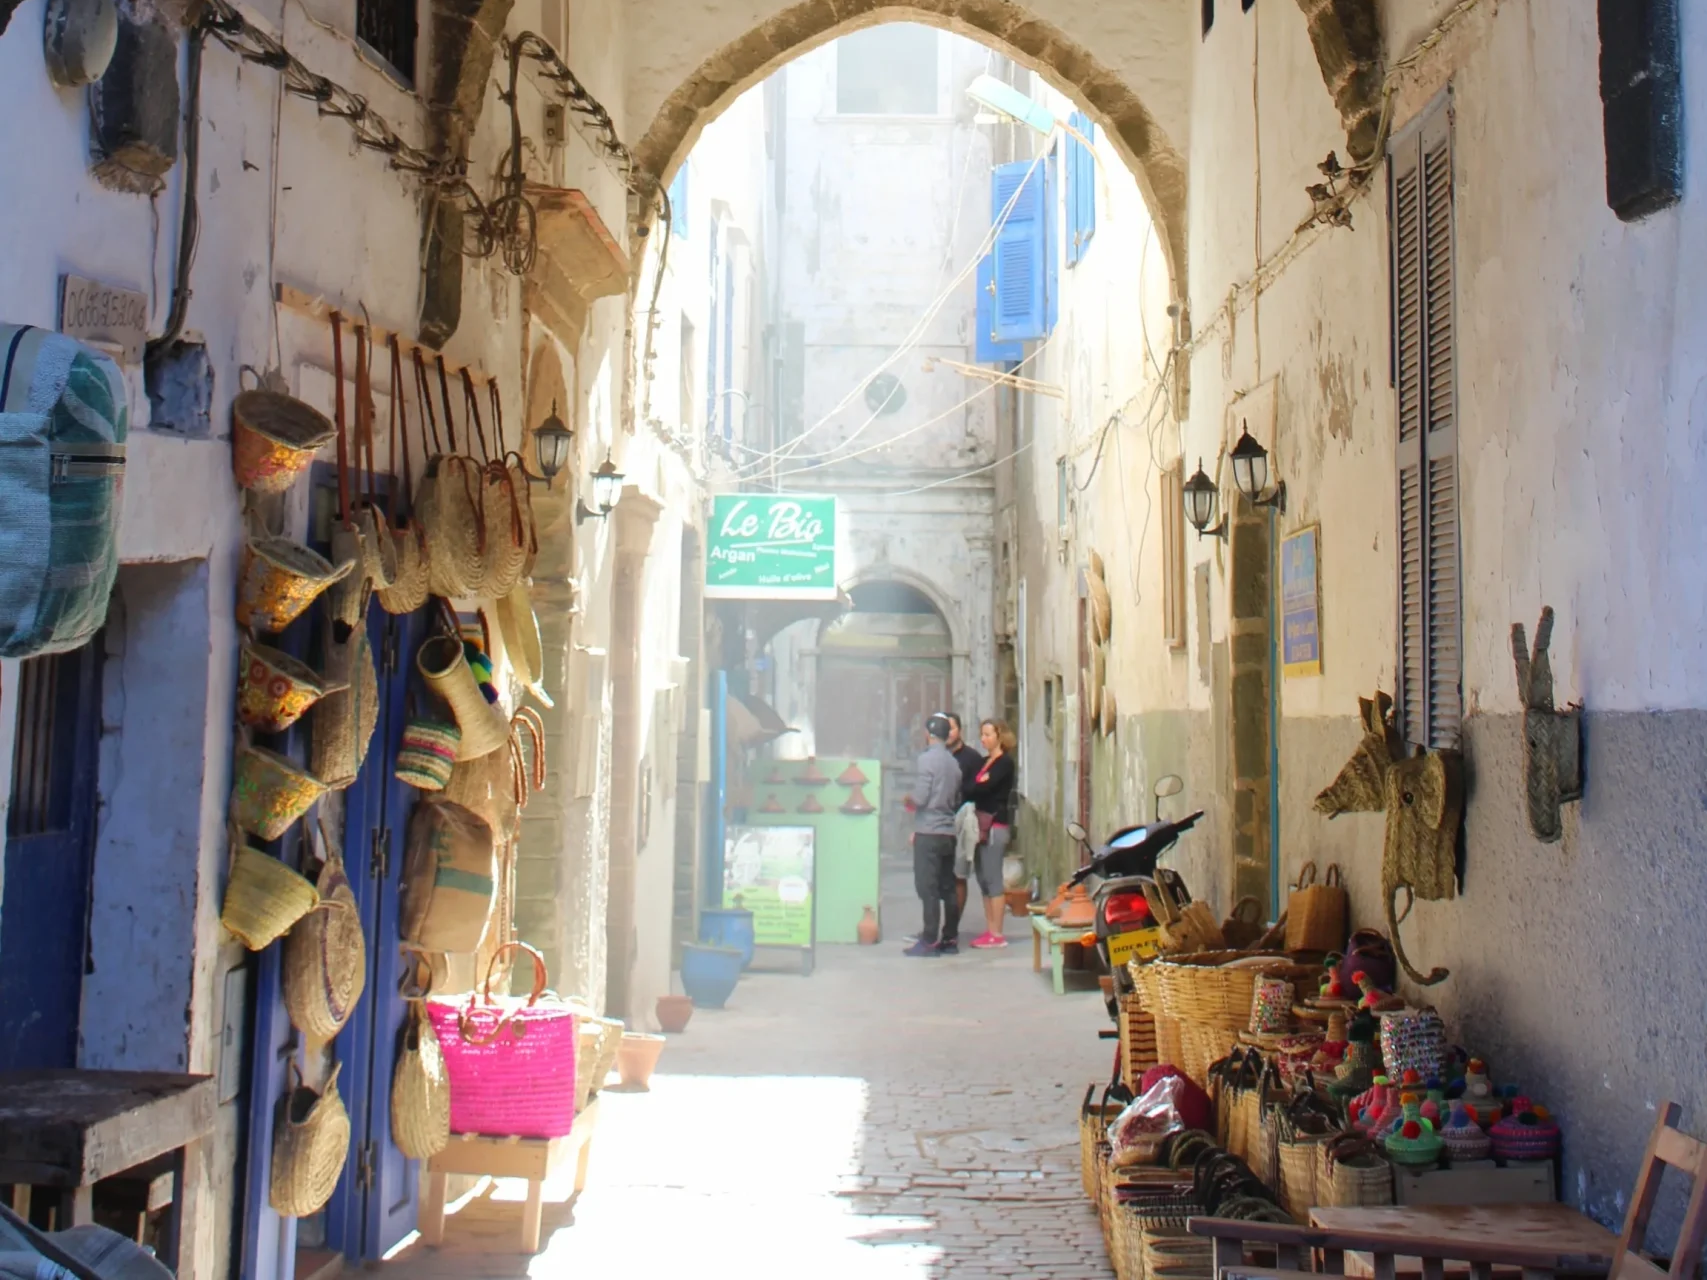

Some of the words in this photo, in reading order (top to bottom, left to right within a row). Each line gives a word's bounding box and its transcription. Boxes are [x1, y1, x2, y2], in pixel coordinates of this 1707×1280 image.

[720, 500, 759, 537] Le
[768, 501, 824, 540] Bio
[710, 545, 756, 563] Argan
